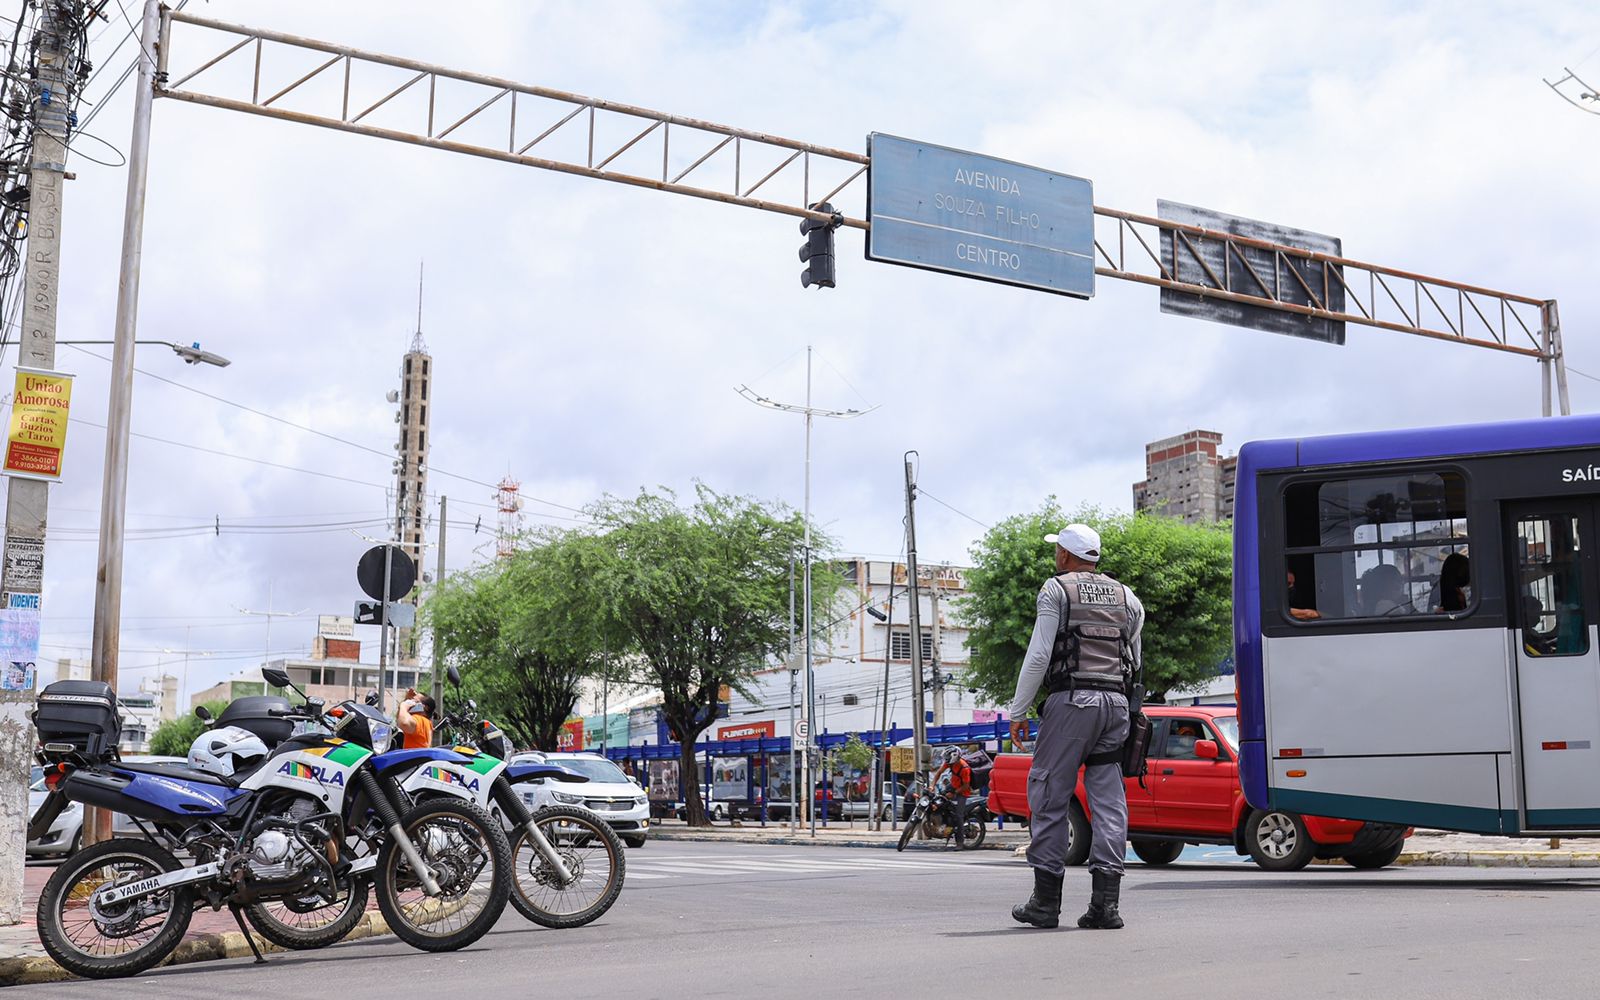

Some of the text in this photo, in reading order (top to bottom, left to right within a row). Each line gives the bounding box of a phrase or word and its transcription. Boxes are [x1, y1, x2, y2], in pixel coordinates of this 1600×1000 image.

[955, 168, 1021, 196] AVENIDA
[935, 193, 1039, 229] SOUZA FILHO
[956, 243, 1020, 270] CENTRO
[15, 391, 69, 408] Amorosa
[28, 430, 53, 442] Tarot
[1080, 583, 1115, 596] AGENTE
[10, 593, 39, 609] VIDENTE
[120, 879, 160, 897] YAMAHA
